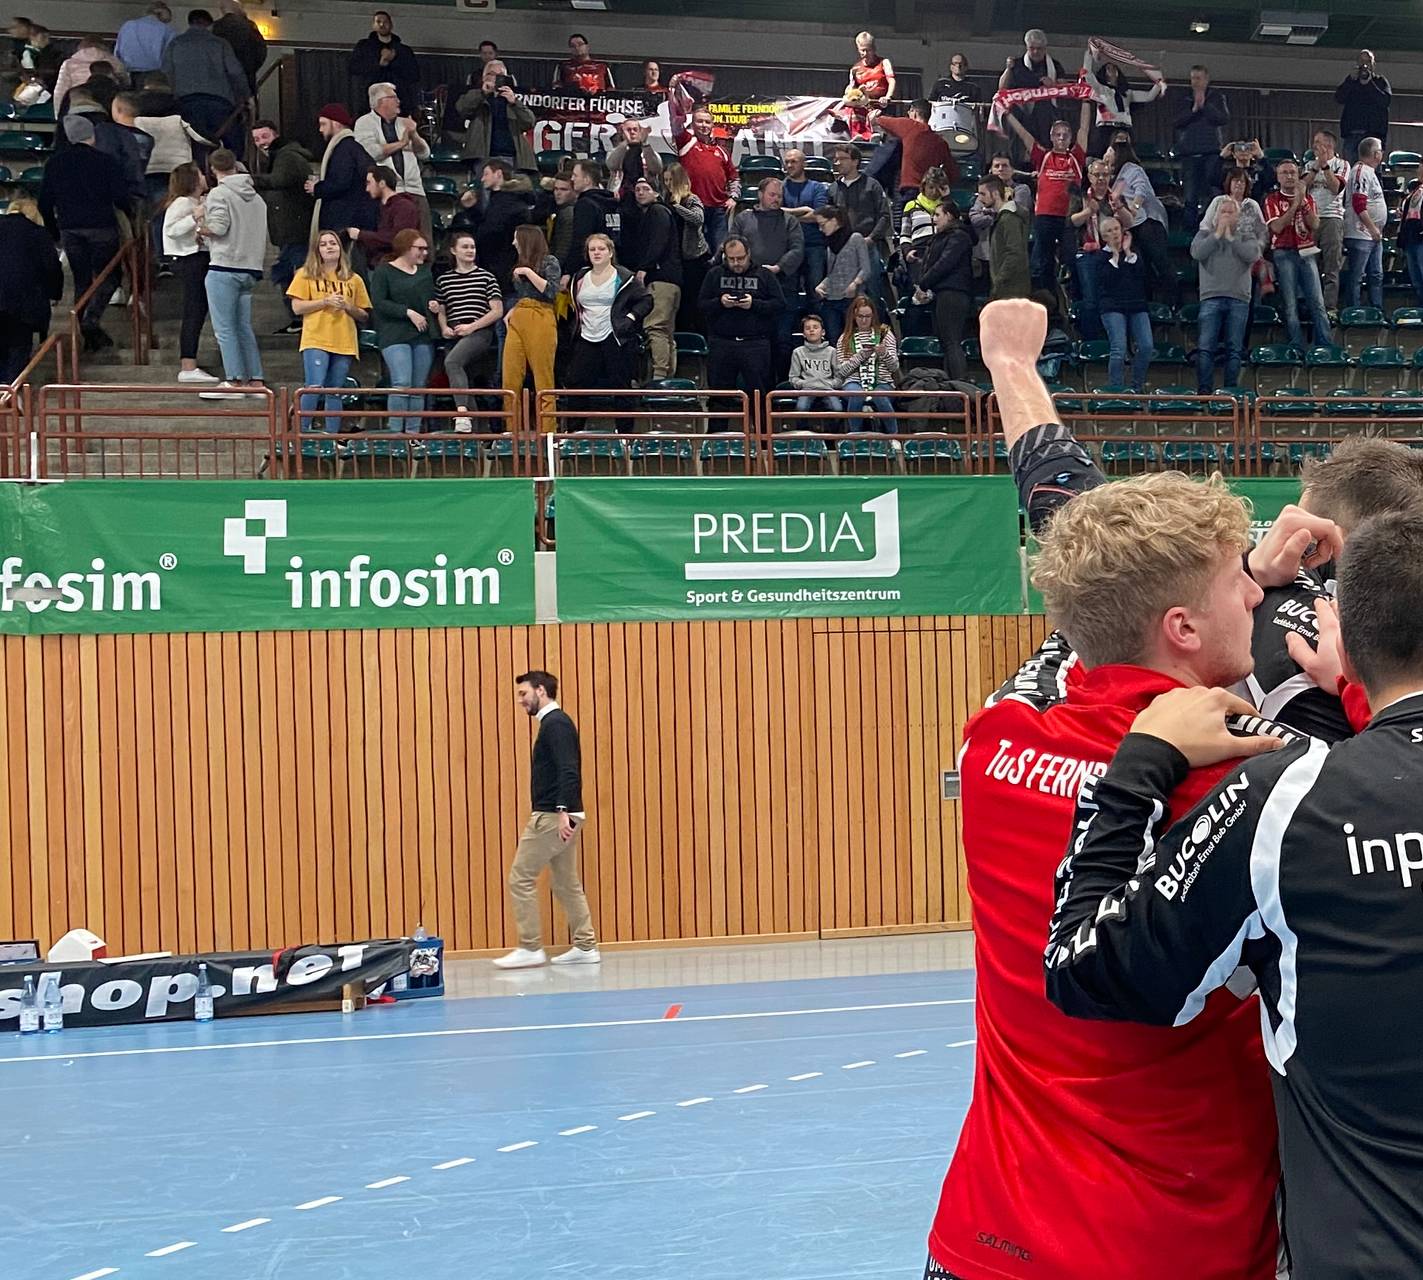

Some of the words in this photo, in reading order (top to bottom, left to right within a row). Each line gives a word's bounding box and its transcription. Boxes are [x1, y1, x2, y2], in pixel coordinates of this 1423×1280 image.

[515, 94, 585, 111] RNDORFER
[590, 99, 643, 114] FÜCHSE
[709, 104, 740, 114] FAMILIE
[804, 359, 830, 371] NYC
[693, 511, 864, 554] PREDIA
[686, 590, 727, 605] Sport
[732, 590, 743, 602] &
[747, 588, 901, 604] Gesundheitszentrum
[985, 739, 1034, 785] TuS
[1025, 753, 1109, 799] FERN
[1224, 800, 1248, 829] GmbH
[1154, 771, 1250, 901] BUCOLIN
